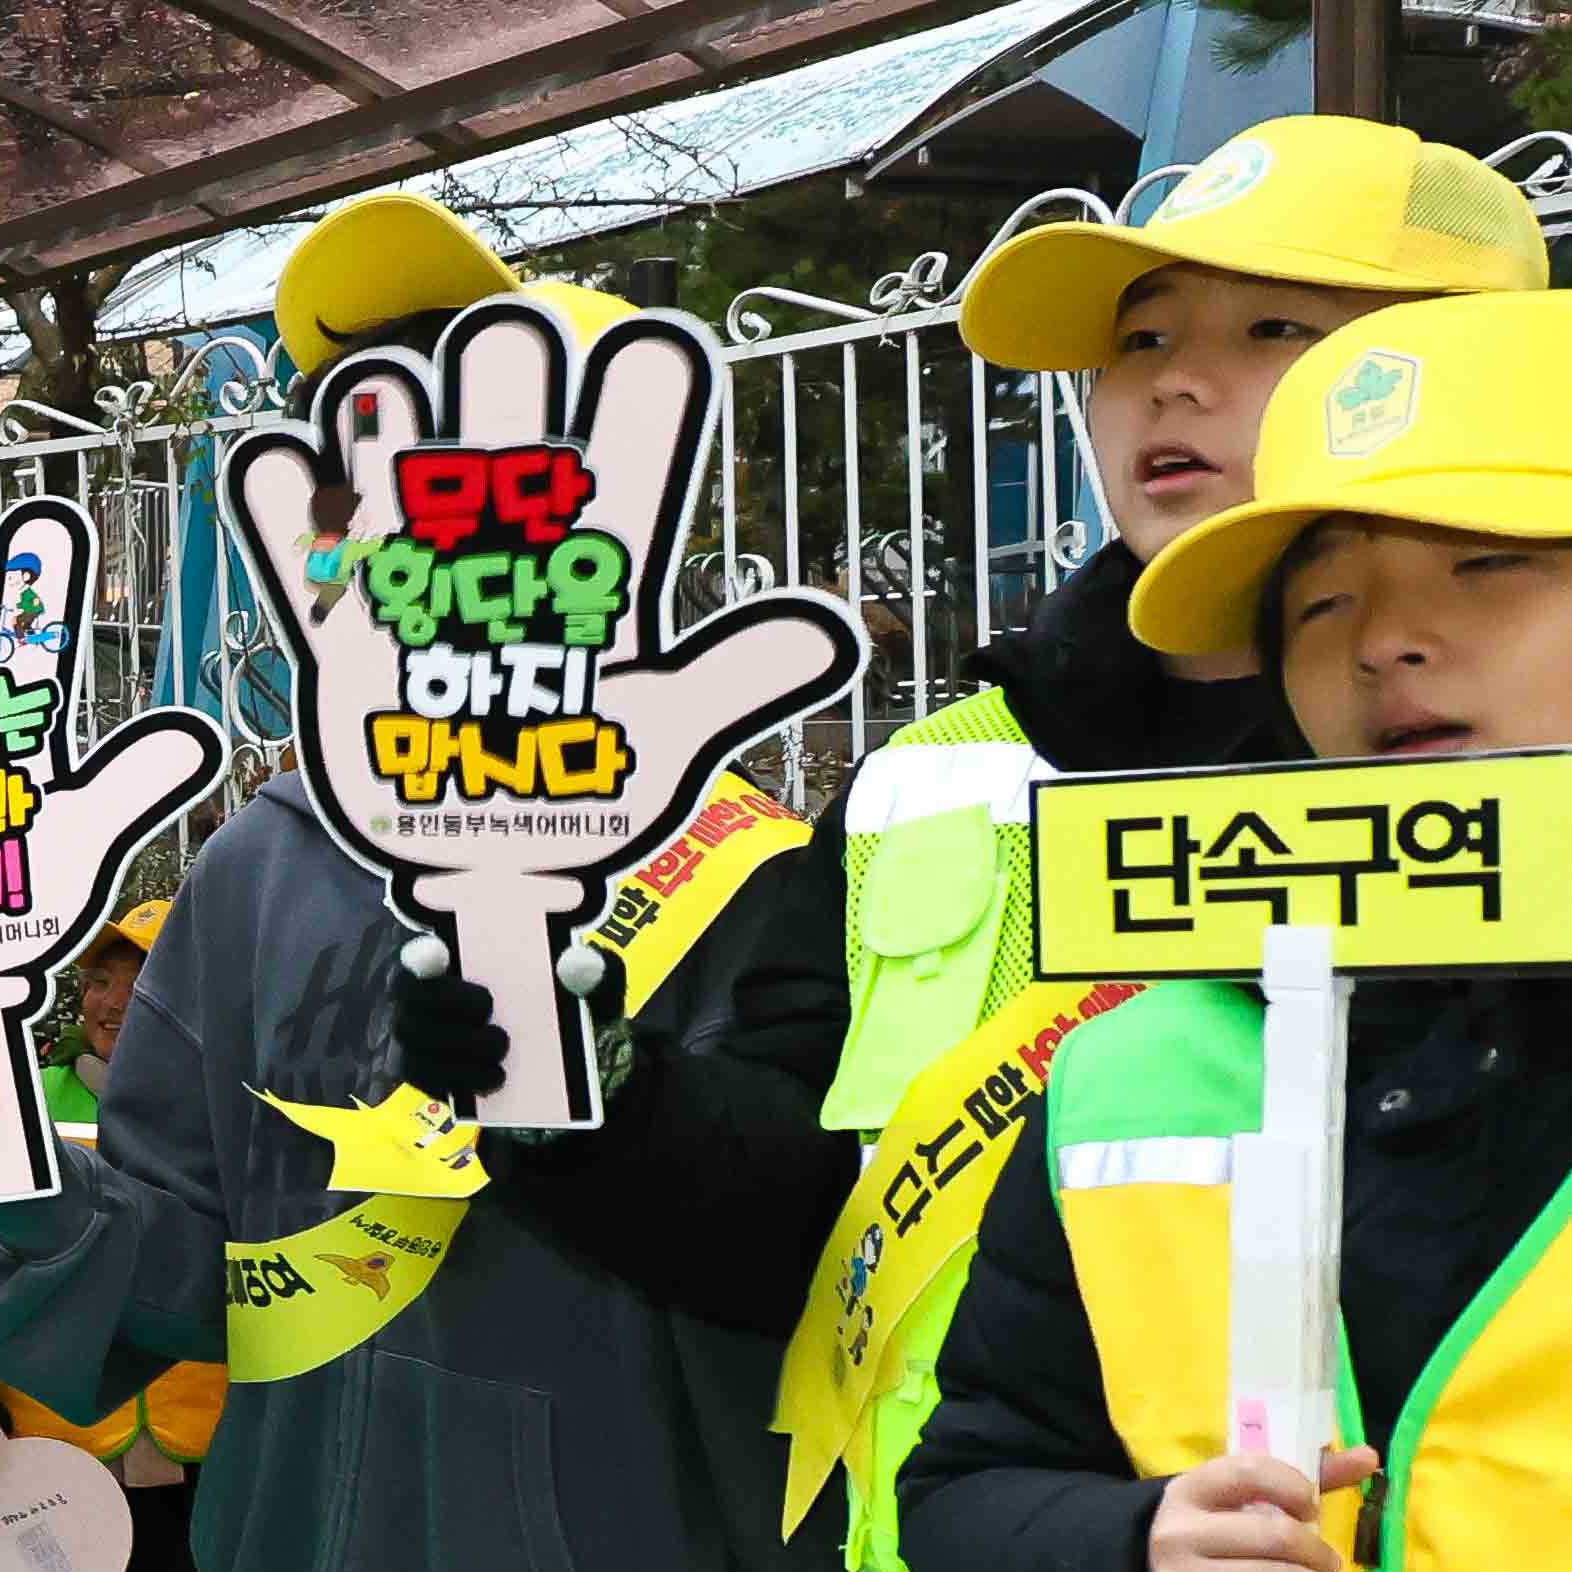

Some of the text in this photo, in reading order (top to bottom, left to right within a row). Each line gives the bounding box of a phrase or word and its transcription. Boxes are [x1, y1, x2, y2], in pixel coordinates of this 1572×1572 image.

[400, 450, 591, 552] 무단
[367, 532, 625, 647] 횡단을
[406, 645, 586, 720] 하지
[372, 717, 628, 800] 맙시다
[397, 813, 632, 840] 용인동부녹색어머니회
[1105, 798, 1502, 934] 단속구역
